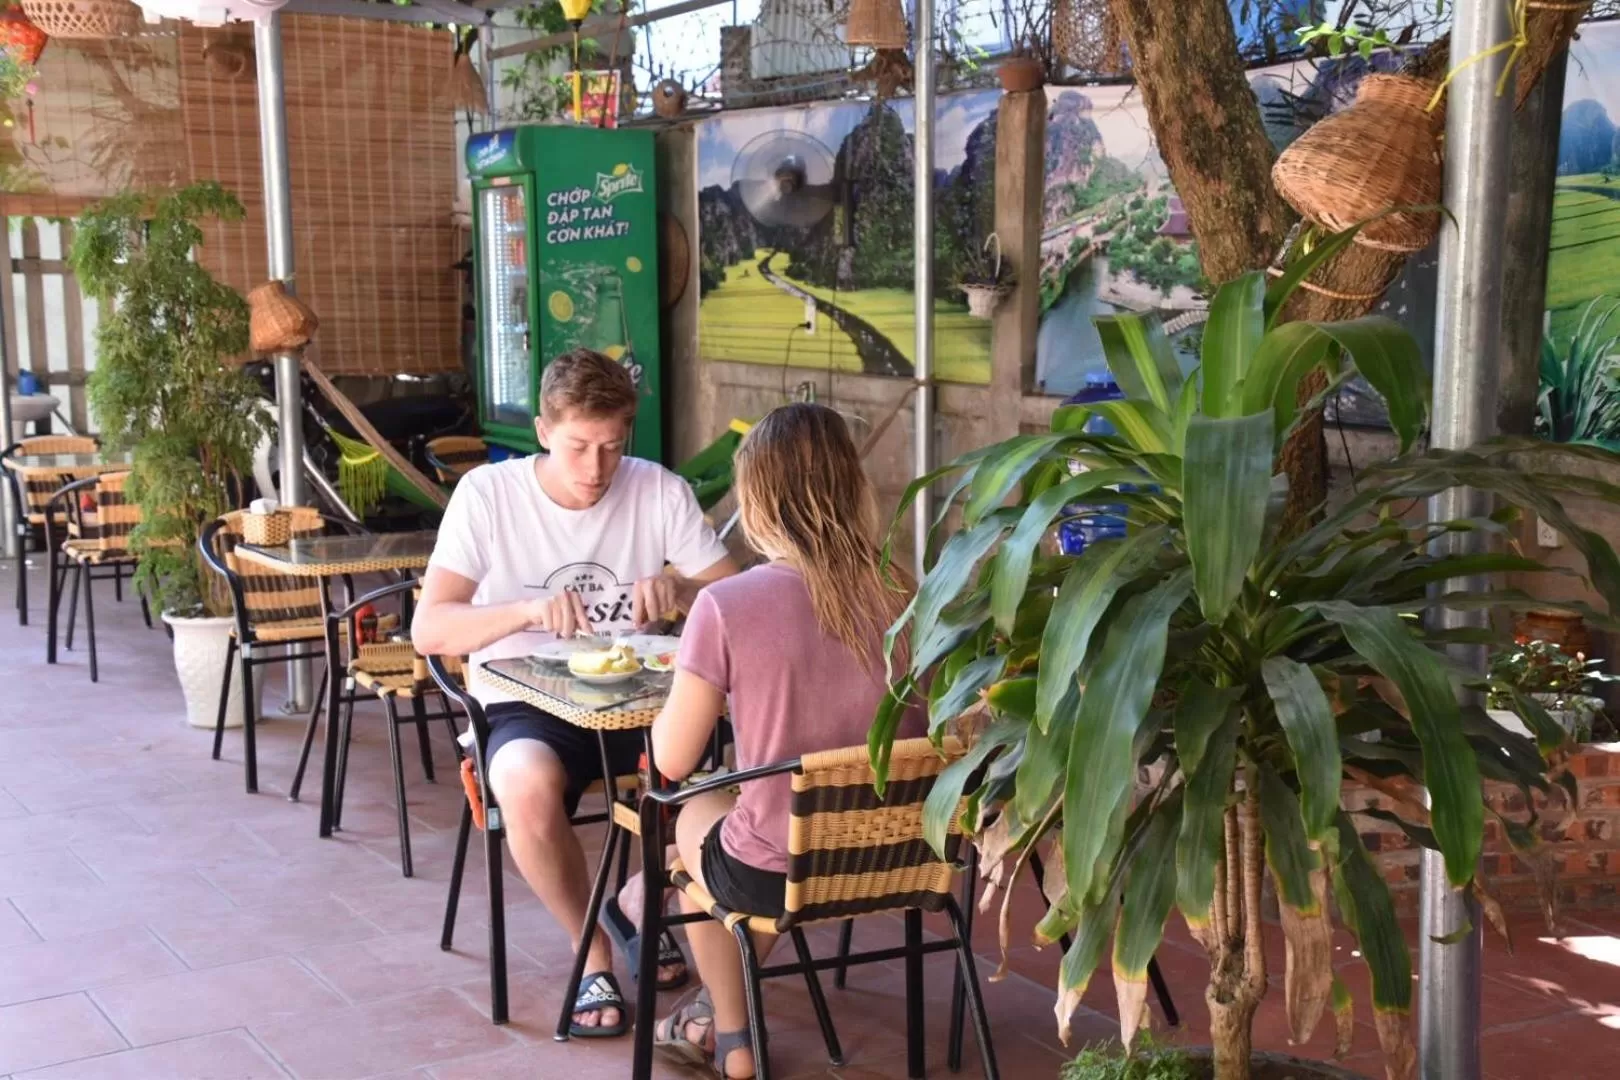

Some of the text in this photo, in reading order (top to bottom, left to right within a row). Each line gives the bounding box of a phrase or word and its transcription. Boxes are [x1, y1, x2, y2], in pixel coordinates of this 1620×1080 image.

[597, 172, 638, 198] Sprite
[547, 186, 591, 207] CHỚP
[583, 205, 613, 221] TAN
[547, 220, 629, 244] CƠN KHÁT!
